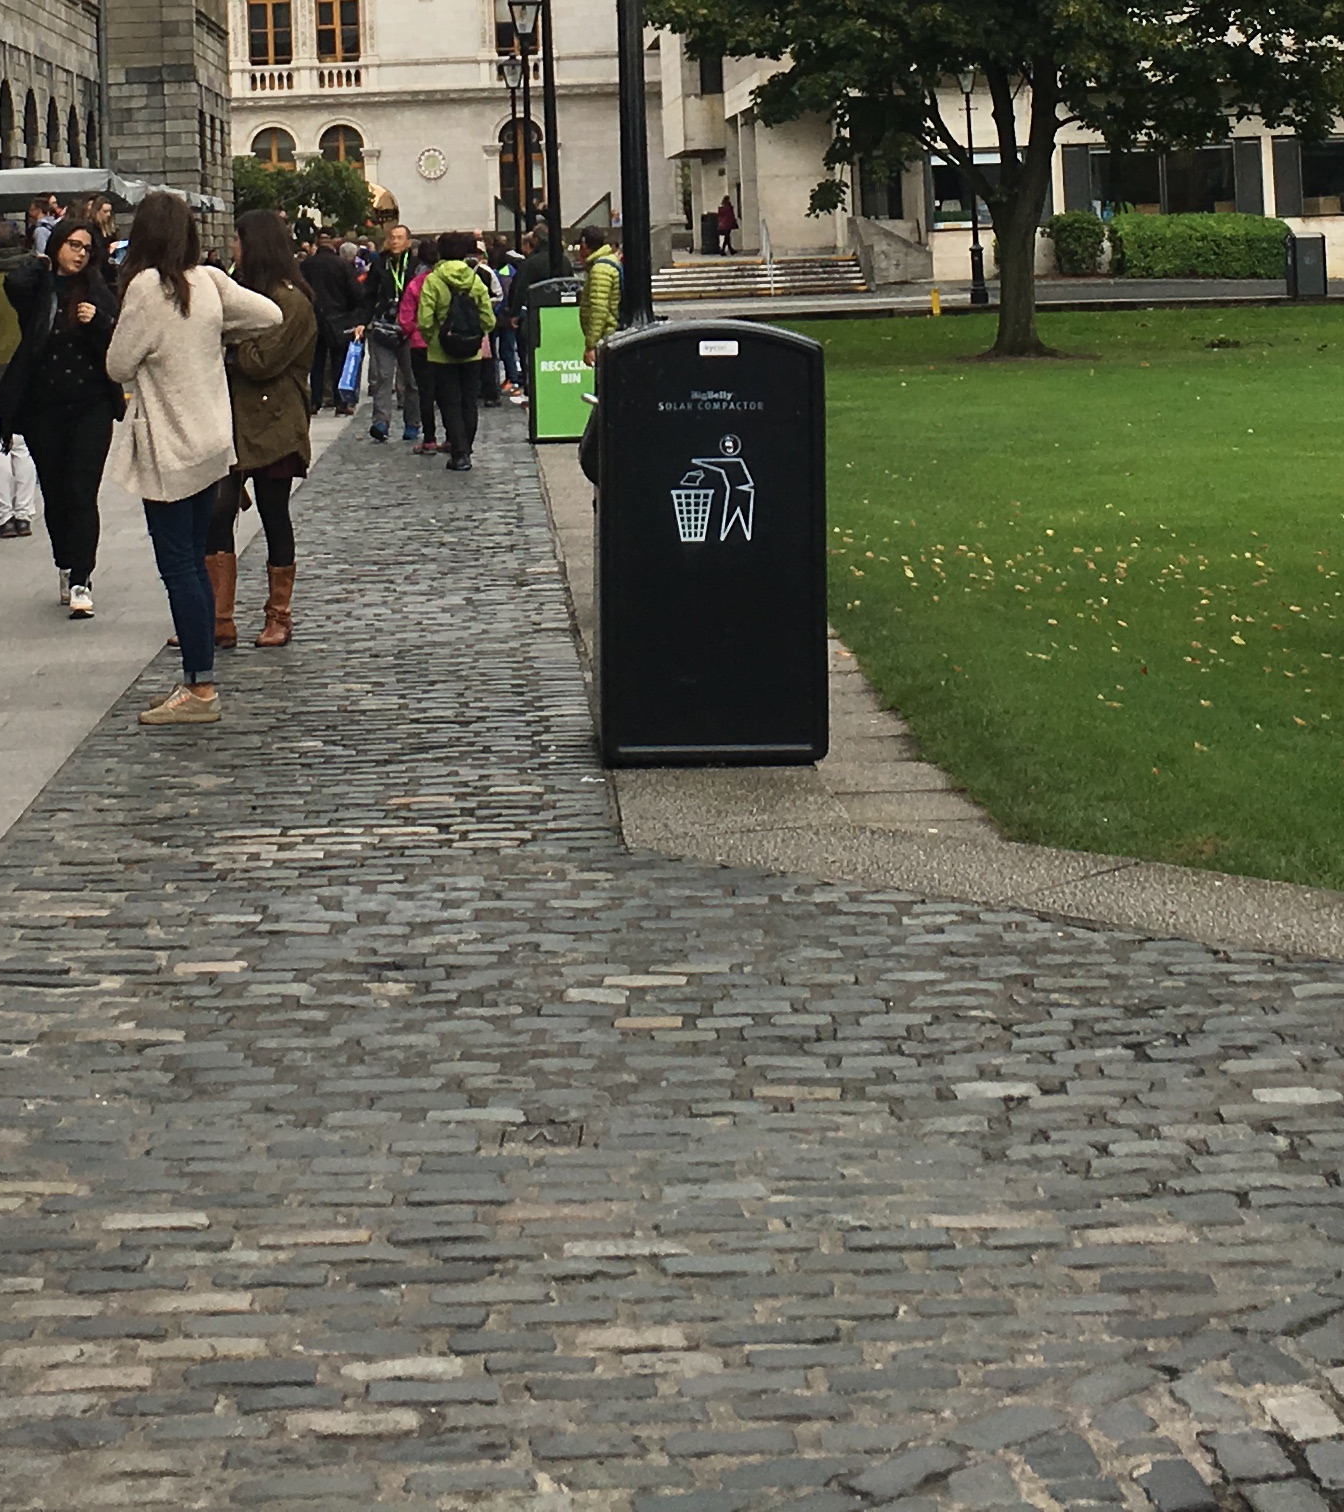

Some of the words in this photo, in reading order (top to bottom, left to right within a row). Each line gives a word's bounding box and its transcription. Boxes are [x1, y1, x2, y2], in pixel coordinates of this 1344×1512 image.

[560, 372, 581, 384] BIN
[657, 401, 694, 411] SOLAR
[697, 401, 764, 411] COMPACTOR
